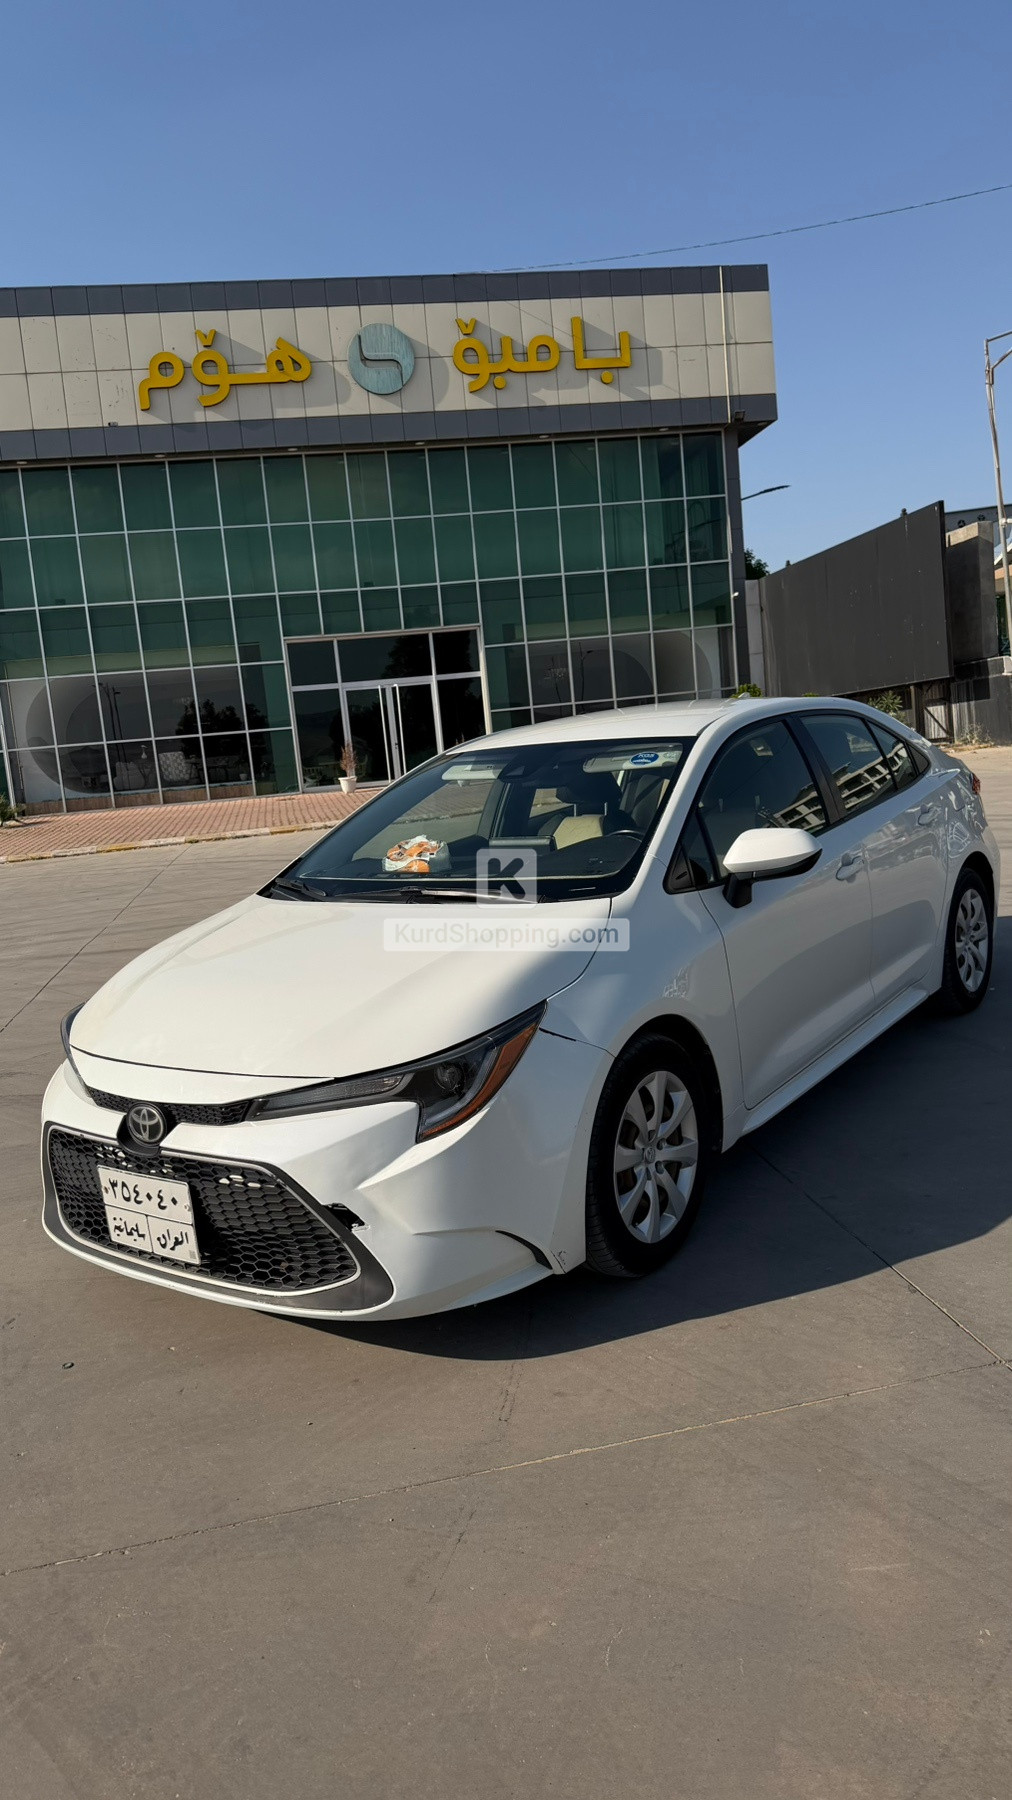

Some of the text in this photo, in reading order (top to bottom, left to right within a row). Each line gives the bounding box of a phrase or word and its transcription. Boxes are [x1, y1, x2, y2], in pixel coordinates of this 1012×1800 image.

[138, 316, 631, 411] بامبۆ هۆم
[108, 1178, 178, 1210] ٣٥٤٠٤٠
